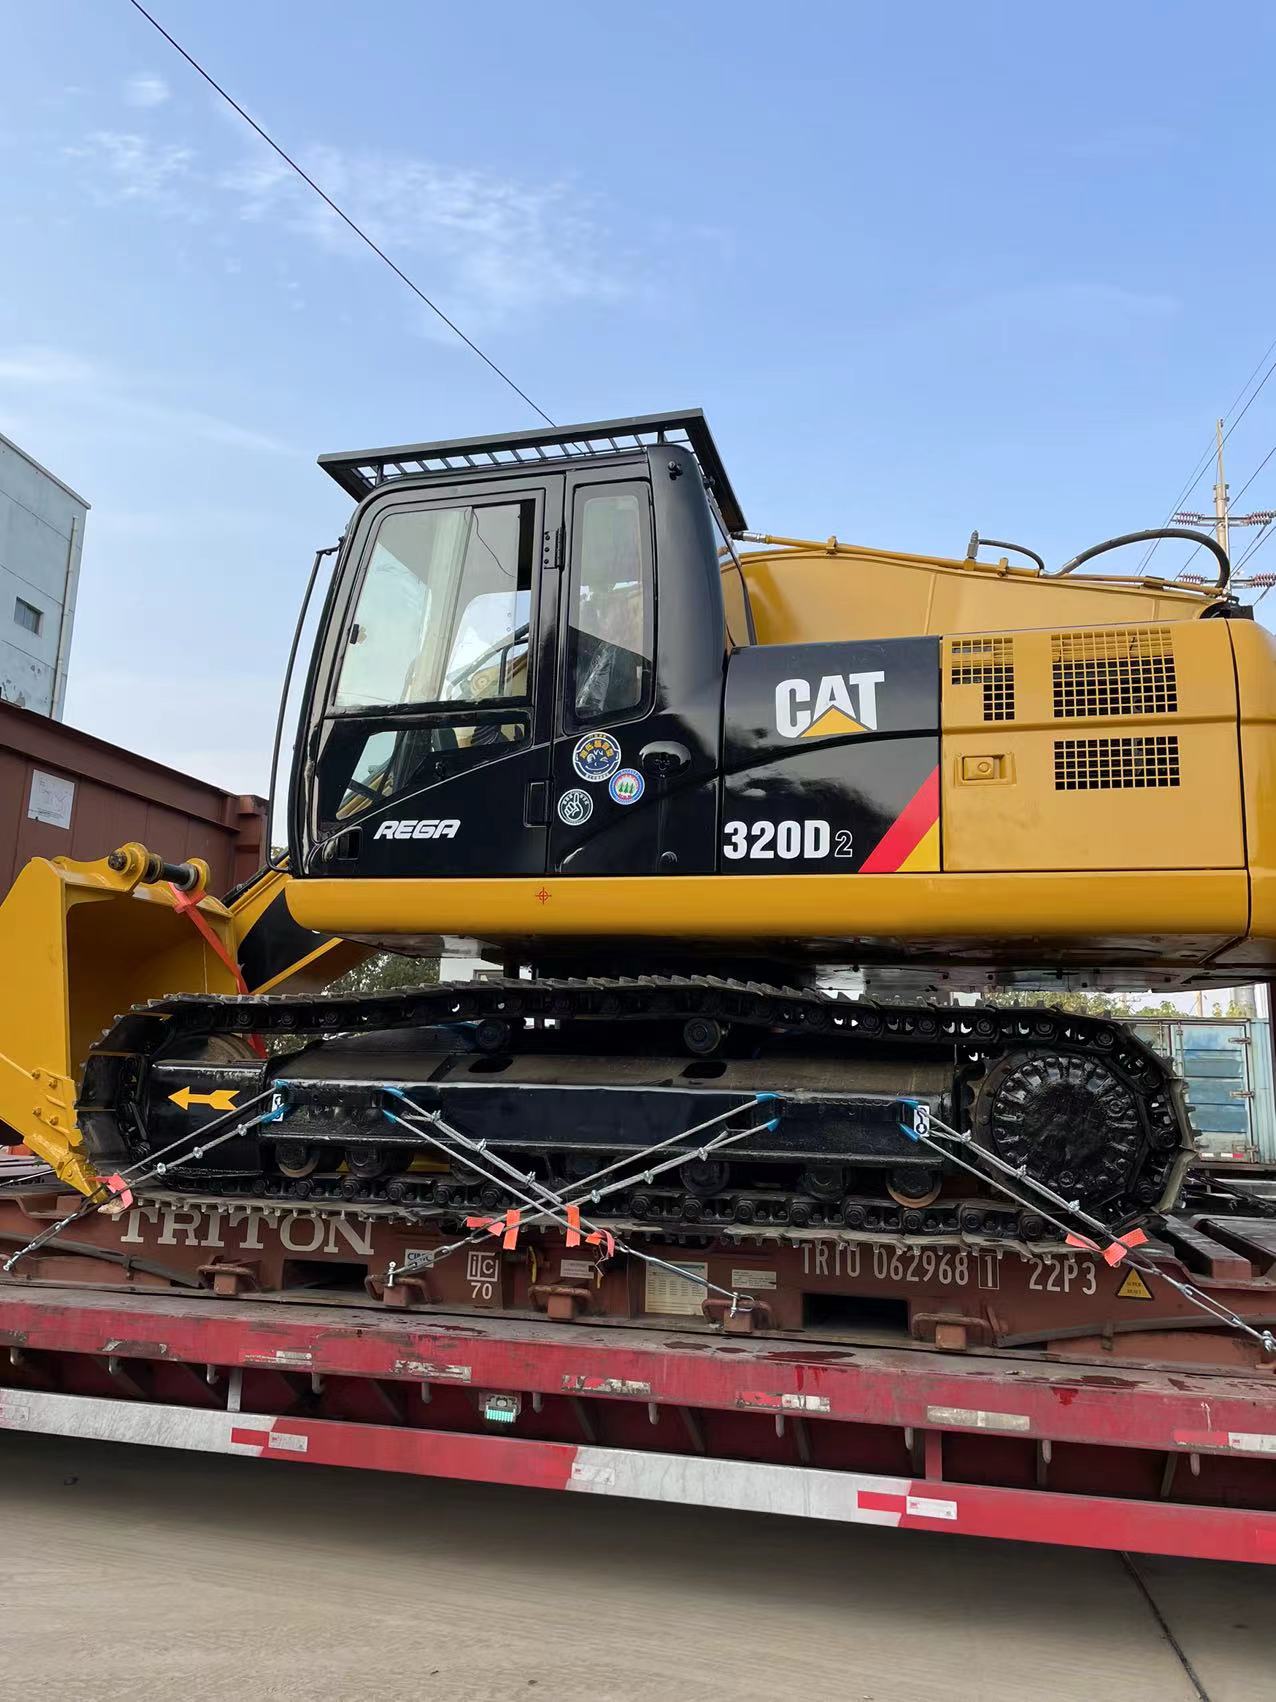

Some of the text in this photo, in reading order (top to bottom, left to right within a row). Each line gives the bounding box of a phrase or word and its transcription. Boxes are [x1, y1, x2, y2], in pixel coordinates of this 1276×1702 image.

[775, 670, 885, 739] CAT
[373, 819, 461, 840] REGA
[111, 1206, 375, 1255] TRITON
[470, 1282, 493, 1300] 70
[873, 1247, 969, 1286] 062968
[1029, 1257, 1097, 1295] 22P3
